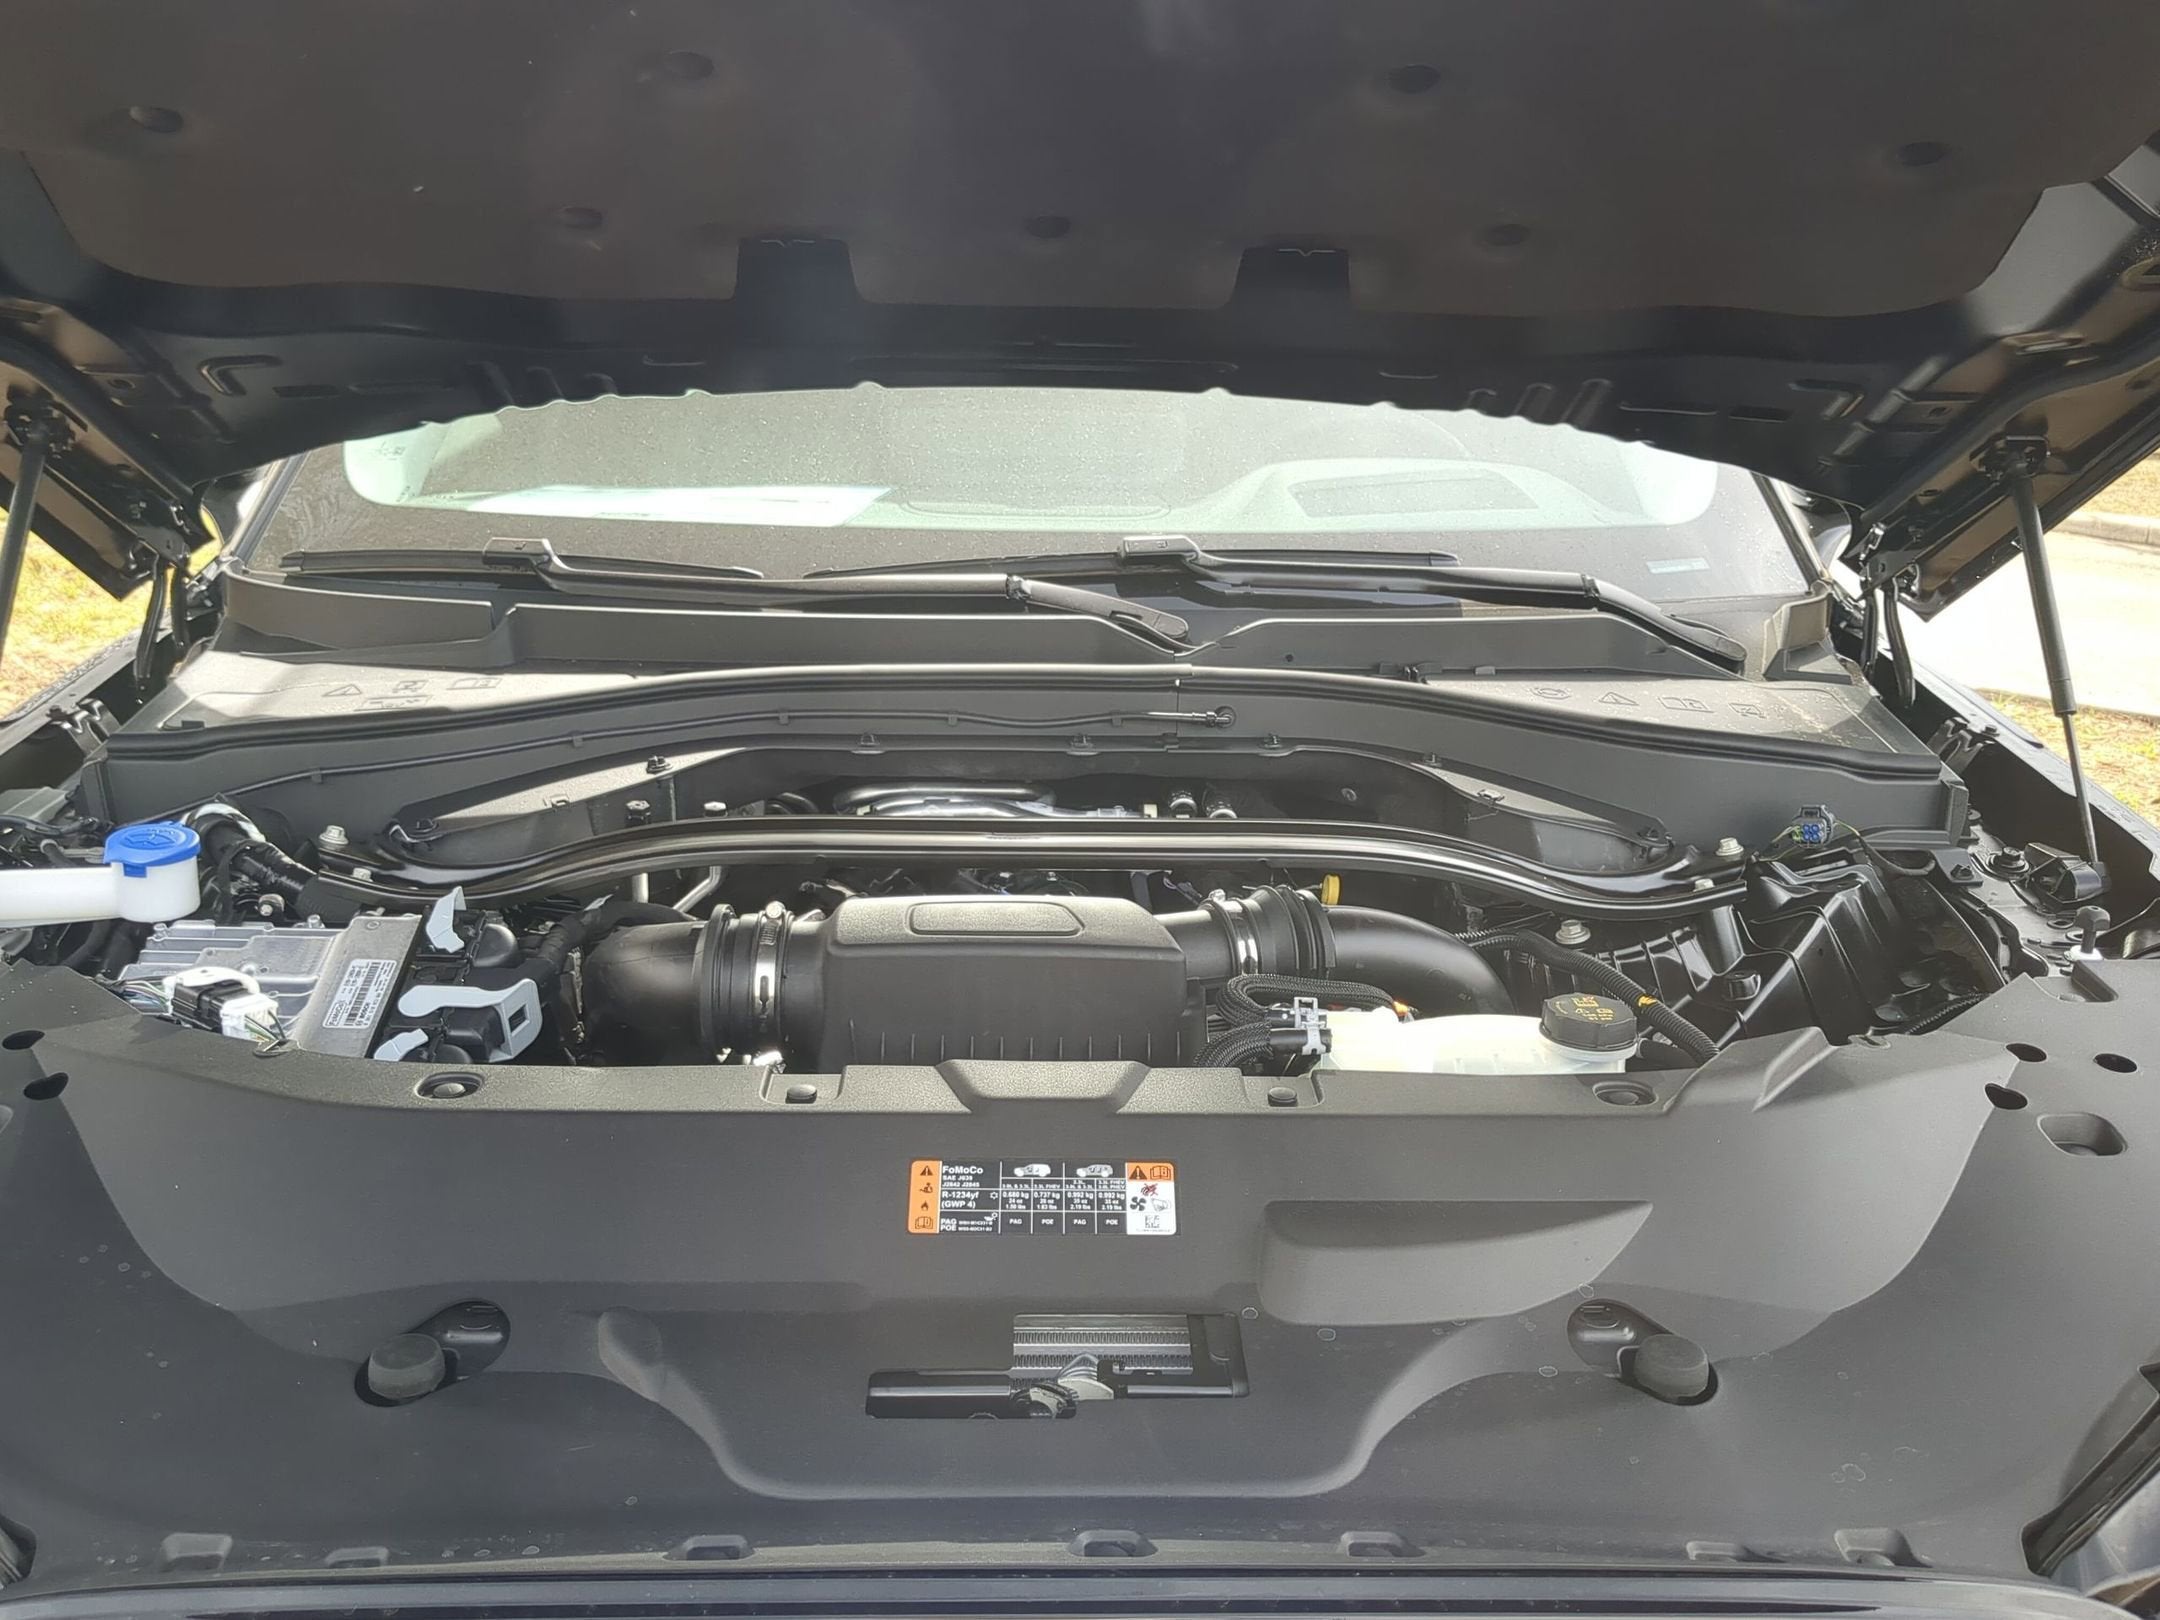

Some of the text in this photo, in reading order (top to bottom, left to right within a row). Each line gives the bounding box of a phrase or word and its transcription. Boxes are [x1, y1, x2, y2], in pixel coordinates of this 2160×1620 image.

[942, 1165, 984, 1175] FoMoCo
[941, 1190, 979, 1201] R-1234yf
[1020, 1191, 1030, 1199] kg
[1051, 1192, 1061, 1200] kg
[1085, 1192, 1094, 1200] kg
[1116, 1192, 1126, 1200] kg
[941, 1200, 976, 1209] (GWP 4)
